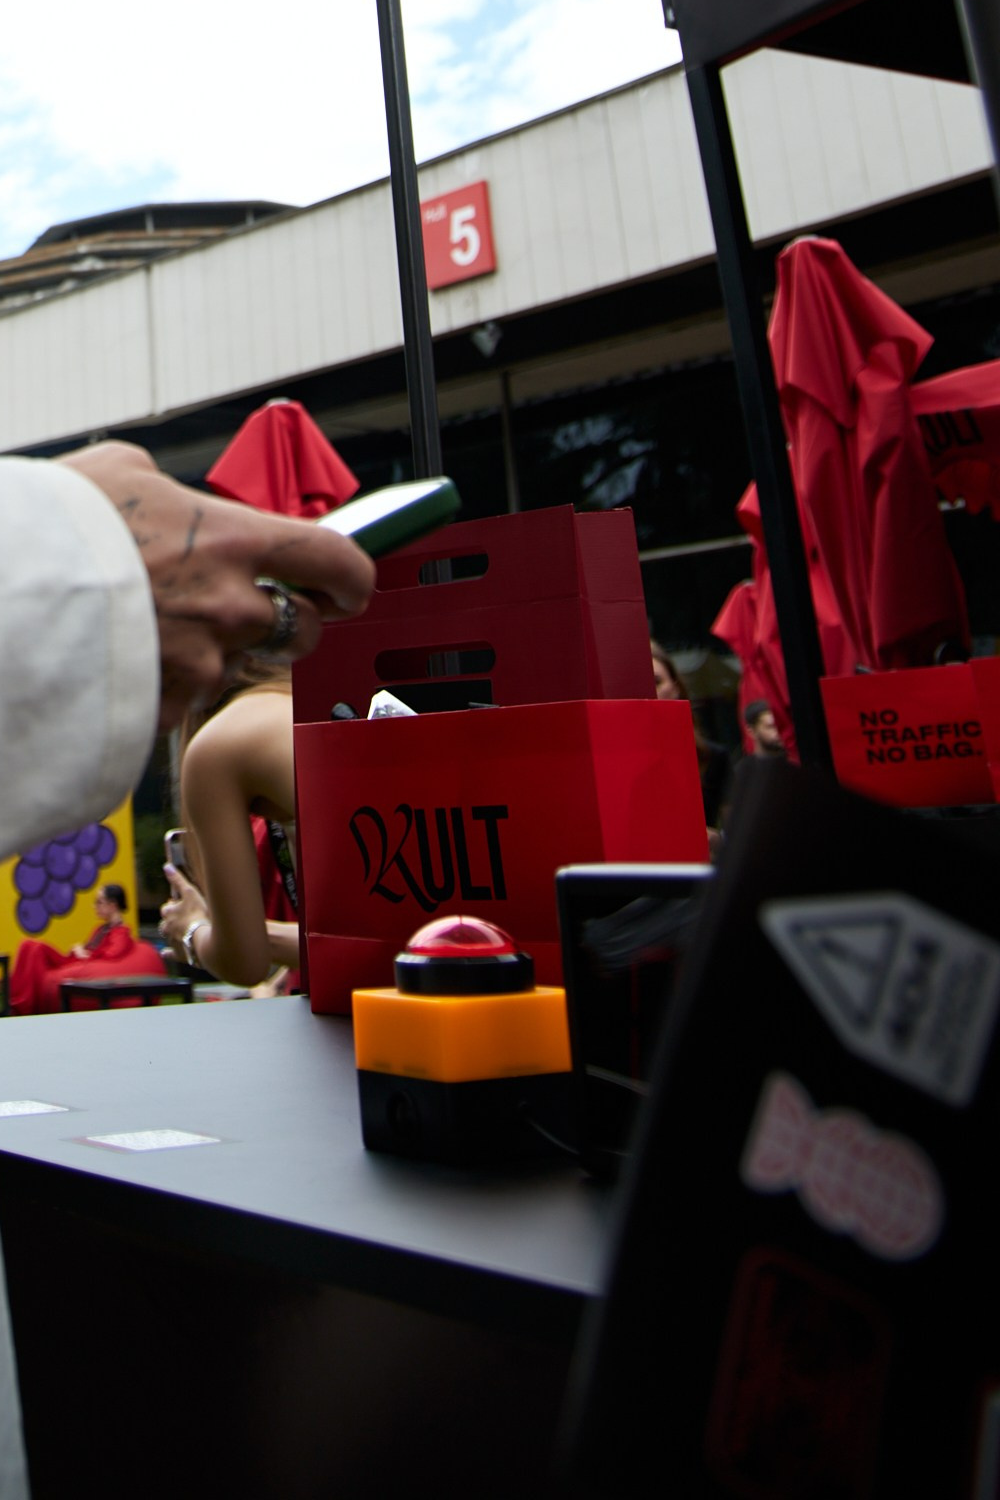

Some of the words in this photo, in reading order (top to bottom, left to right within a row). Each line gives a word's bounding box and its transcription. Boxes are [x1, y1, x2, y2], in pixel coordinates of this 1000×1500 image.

[450, 205, 480, 266] 5
[860, 709, 898, 727] NO
[863, 721, 981, 744] TRAFFIC
[867, 747, 906, 765] NO
[914, 741, 983, 761] BAG.
[349, 803, 508, 913] KULT
